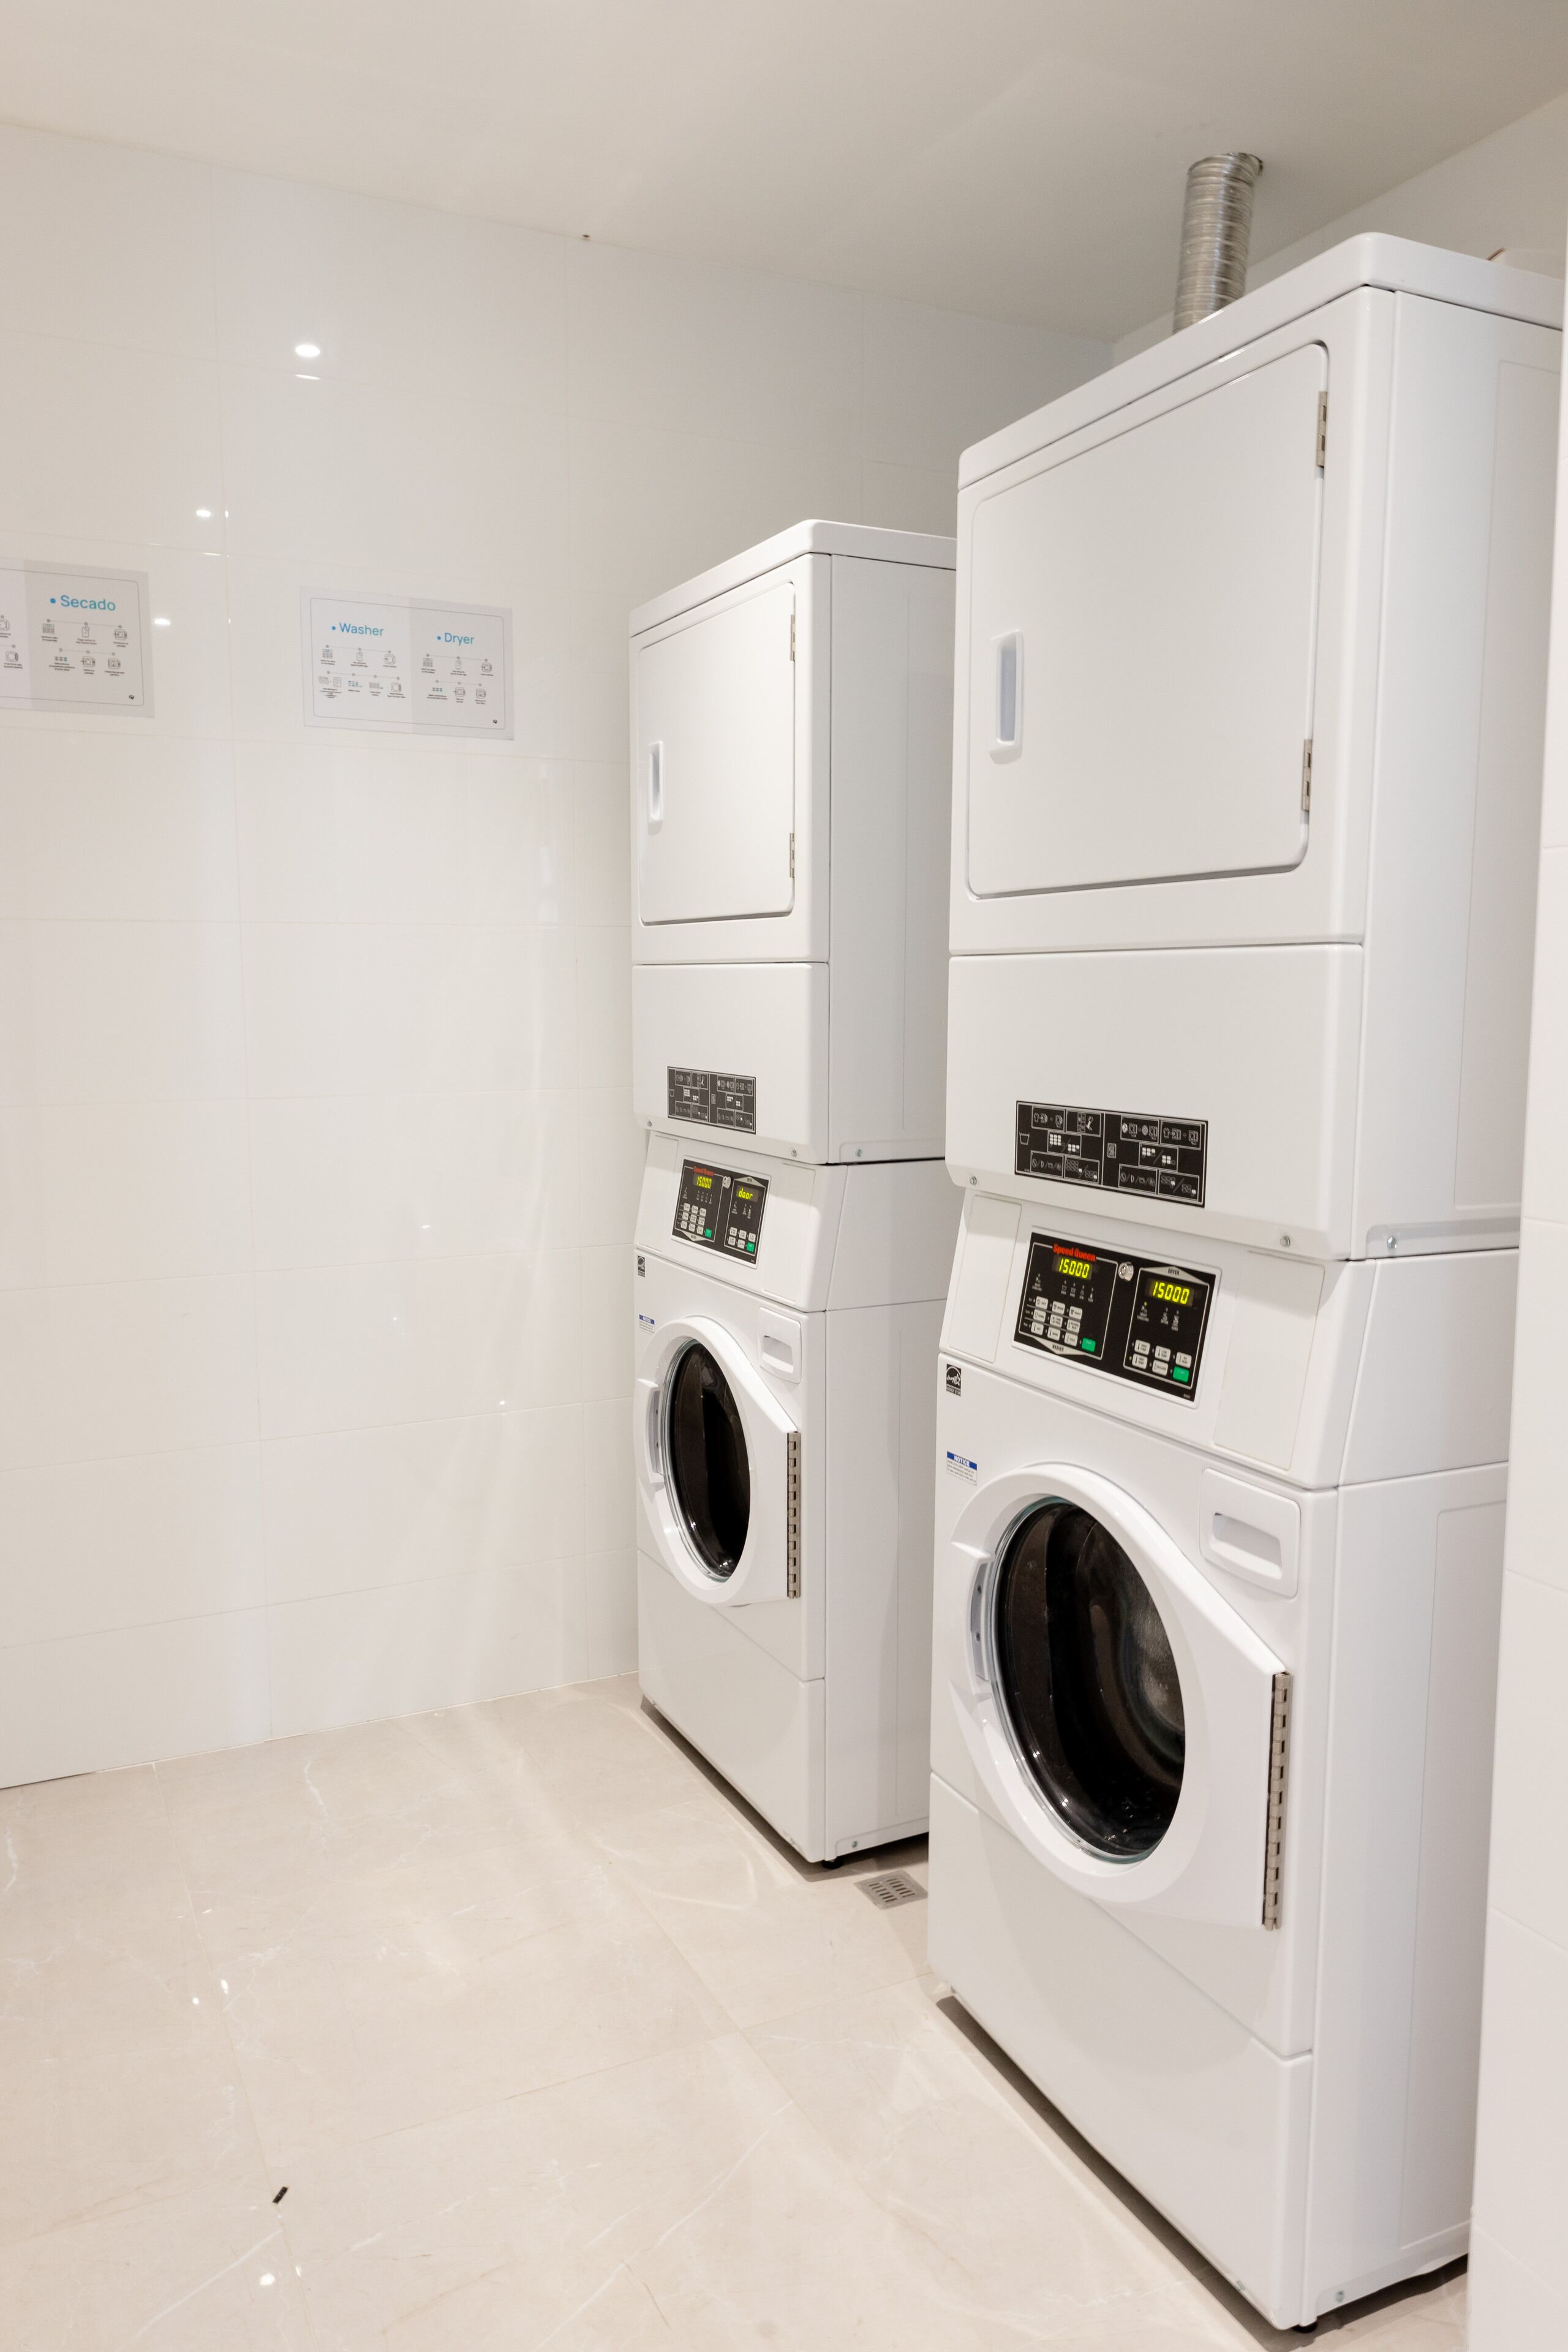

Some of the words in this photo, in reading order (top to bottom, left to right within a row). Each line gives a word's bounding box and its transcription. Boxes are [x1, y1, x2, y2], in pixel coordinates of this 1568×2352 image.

[60, 594, 116, 611] Secado
[339, 622, 384, 636] Washer
[444, 632, 475, 646] Dryer
[696, 1176, 712, 1189] 15000
[1053, 1243, 1074, 1257] Speed
[1074, 1248, 1096, 1262] Queen
[1058, 1257, 1090, 1279] 15000
[1153, 1281, 1190, 1305] 15000
[954, 1455, 970, 1466] NOTICE
